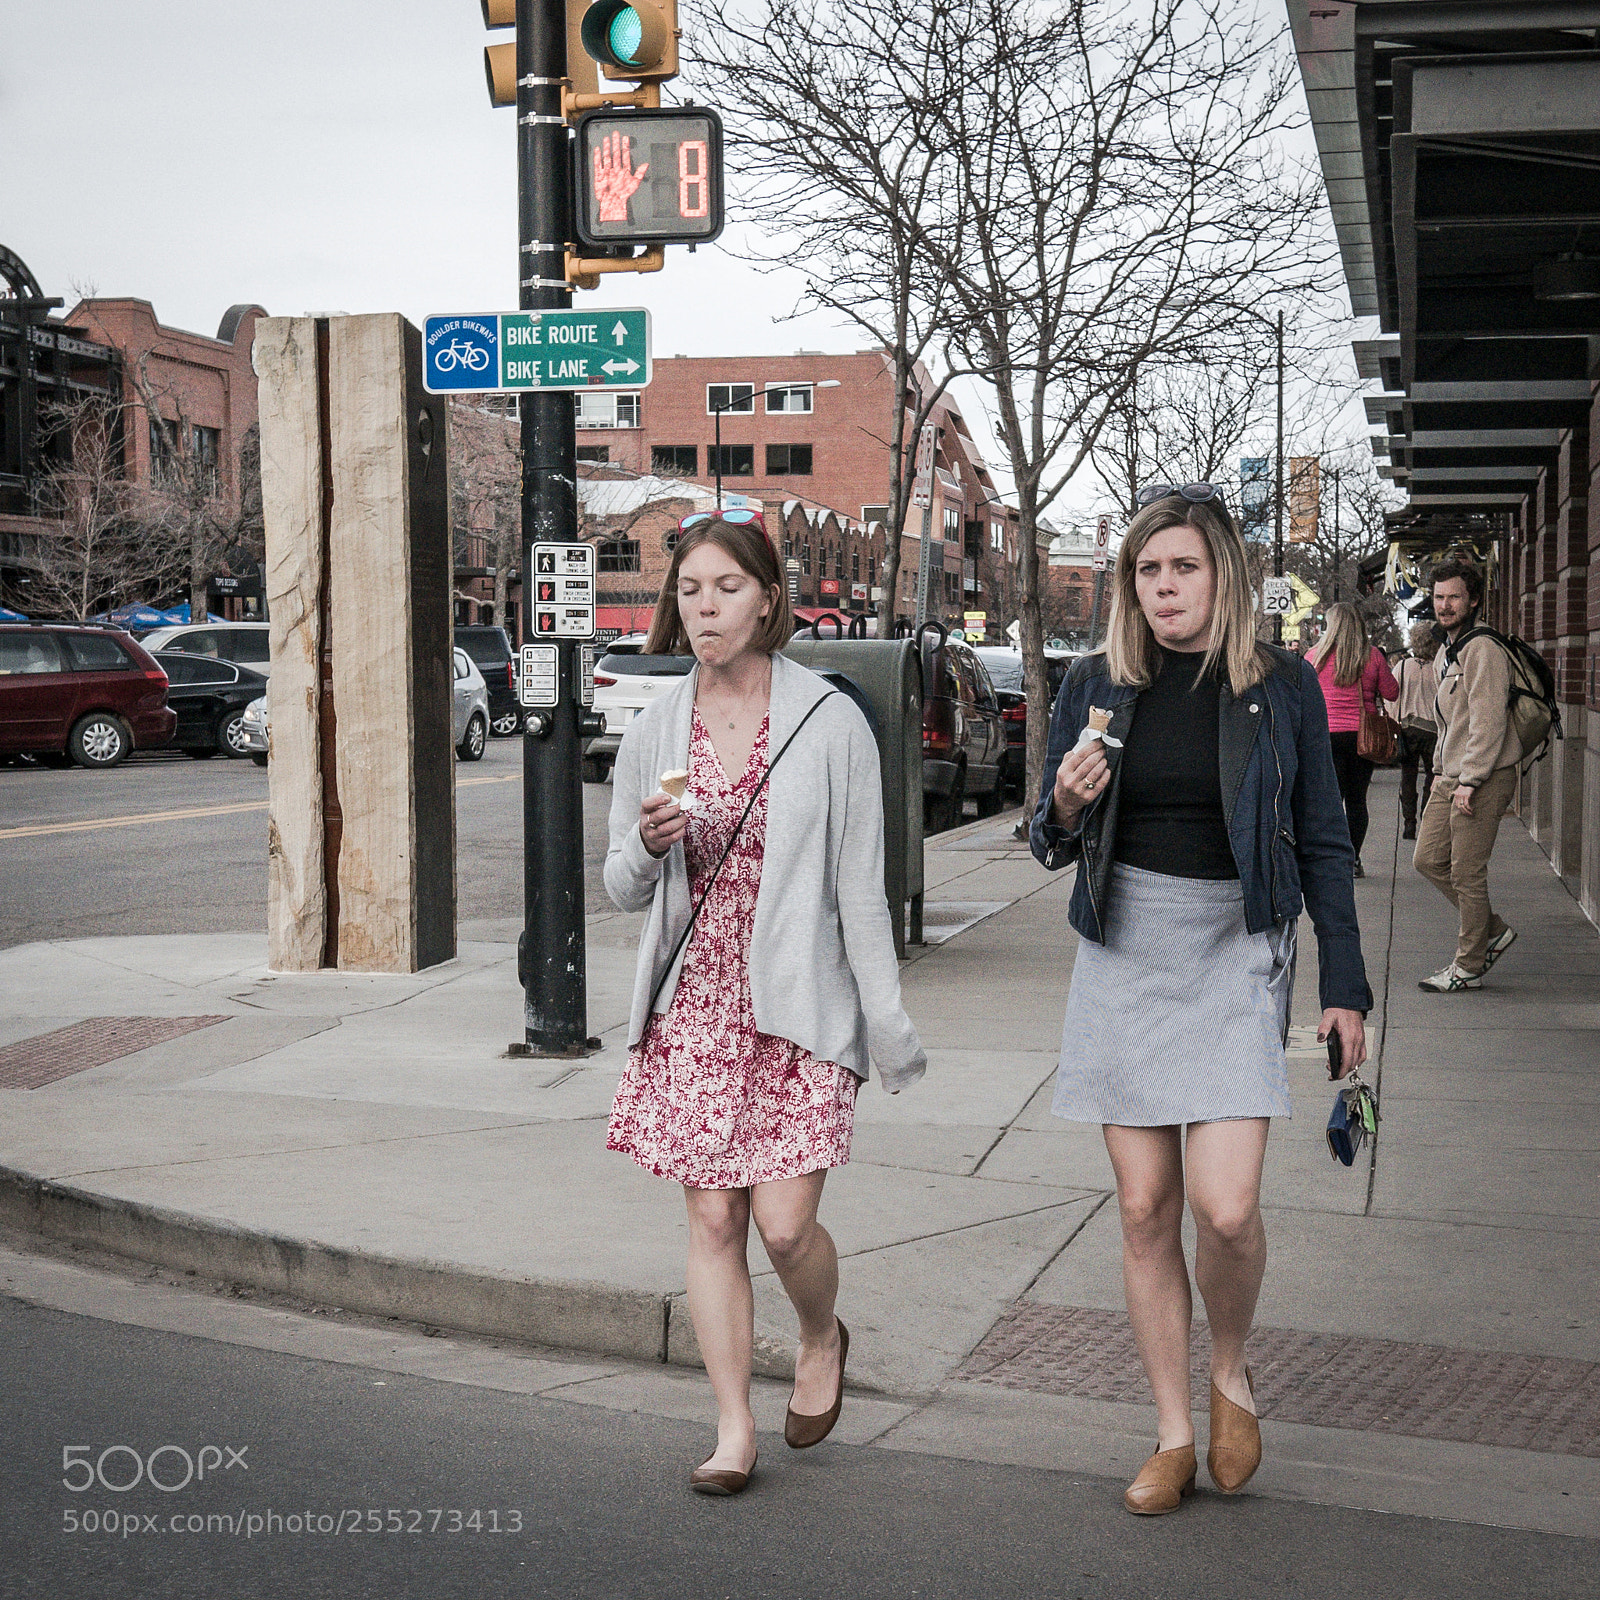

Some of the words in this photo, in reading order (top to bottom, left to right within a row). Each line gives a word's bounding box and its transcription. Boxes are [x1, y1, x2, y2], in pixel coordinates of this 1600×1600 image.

[679, 140, 707, 217] 8
[427, 320, 460, 346] BOULDER
[462, 320, 497, 344] BIKEWAYS
[507, 327, 542, 345] BIKE
[548, 325, 598, 344] ROUTE
[507, 361, 542, 379] BIKE
[548, 360, 588, 378] LANE
[1267, 596, 1289, 610] 20
